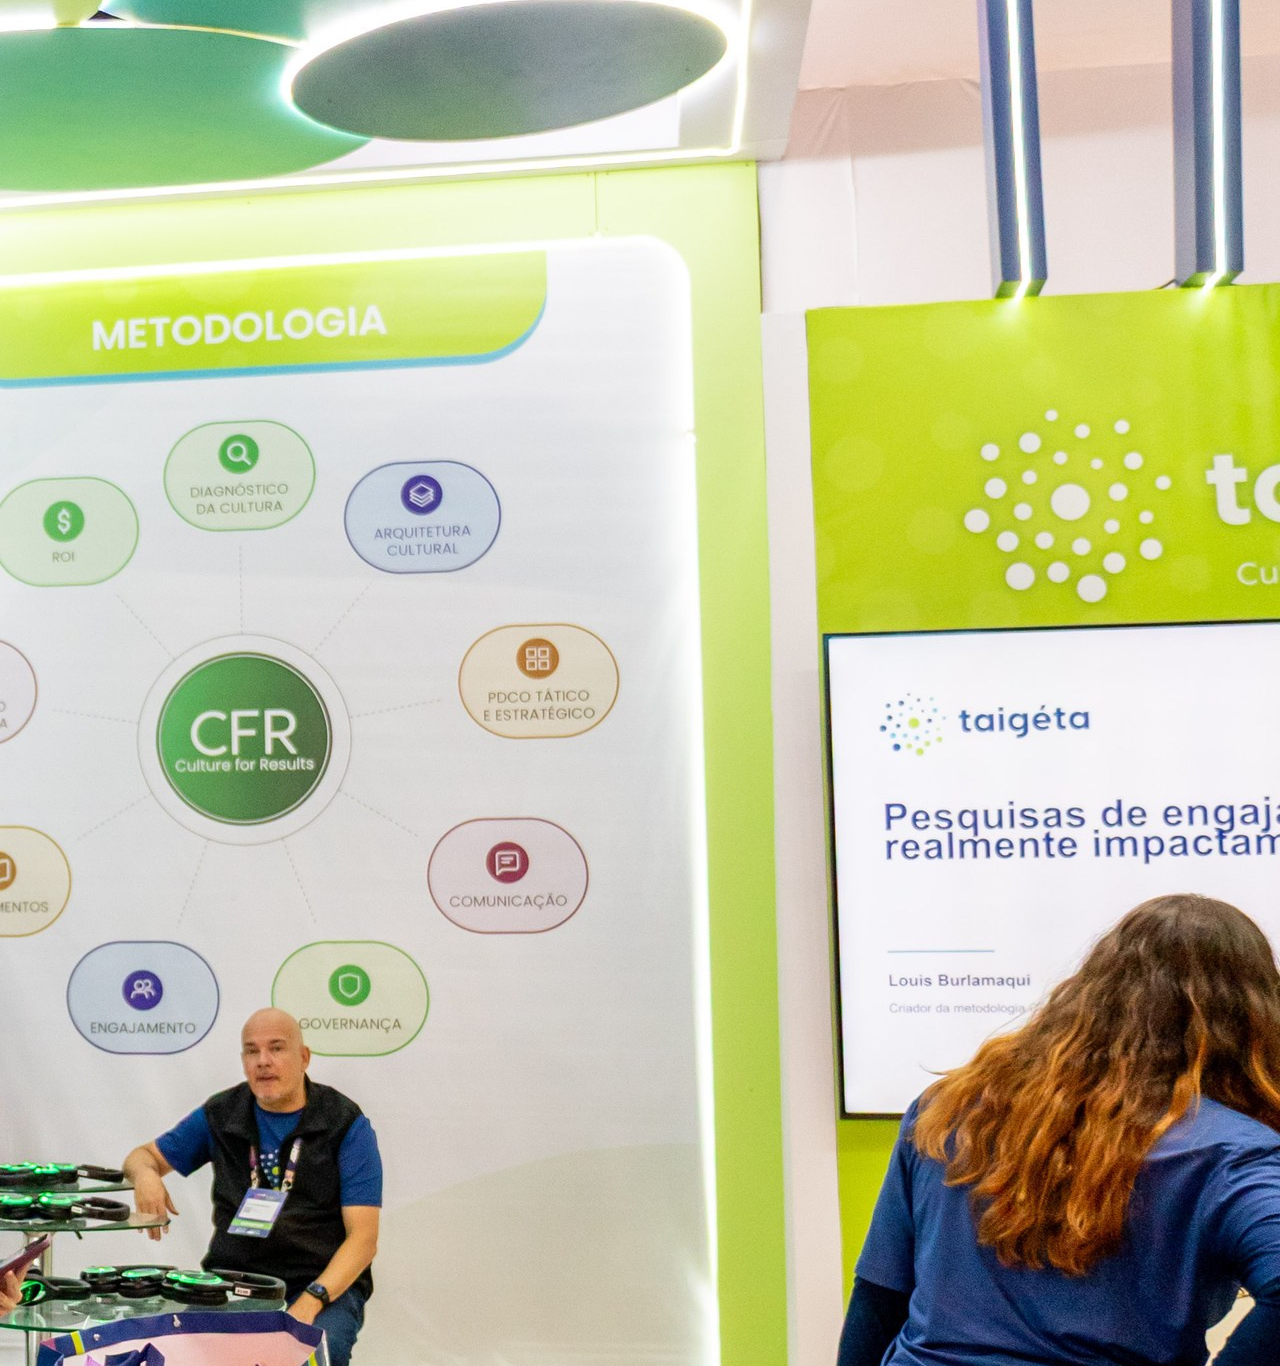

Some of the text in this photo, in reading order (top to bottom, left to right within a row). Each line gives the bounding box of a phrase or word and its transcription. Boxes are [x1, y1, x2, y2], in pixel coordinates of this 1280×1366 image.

[91, 304, 387, 351] METODOLOGIA
[189, 483, 289, 499] DIAGNÓSTICO
[196, 500, 283, 516] DA CULTURA
[373, 524, 472, 541] ARQUITETURA
[52, 551, 75, 564] ROI
[386, 543, 460, 557] CULTURAL
[487, 687, 591, 705] PDCO TÁTICO
[483, 705, 596, 722] E ESTRATÉGICO
[958, 705, 1091, 739] taigéta
[190, 708, 297, 756] CFR
[175, 756, 315, 773] Culture for Results
[884, 801, 1086, 836] Pesquisas
[1101, 798, 1147, 827] de
[885, 831, 1078, 860] realmente
[449, 893, 568, 910] COMUNICAÇÃO
[888, 974, 1031, 989] Louis Burlamaqui
[889, 1003, 932, 1014] Criador
[935, 1003, 951, 1014] da
[953, 1003, 1026, 1016] metodologia
[90, 1021, 197, 1035] ENGAJAMENTO
[297, 1017, 402, 1034] GOVERNANÇA
